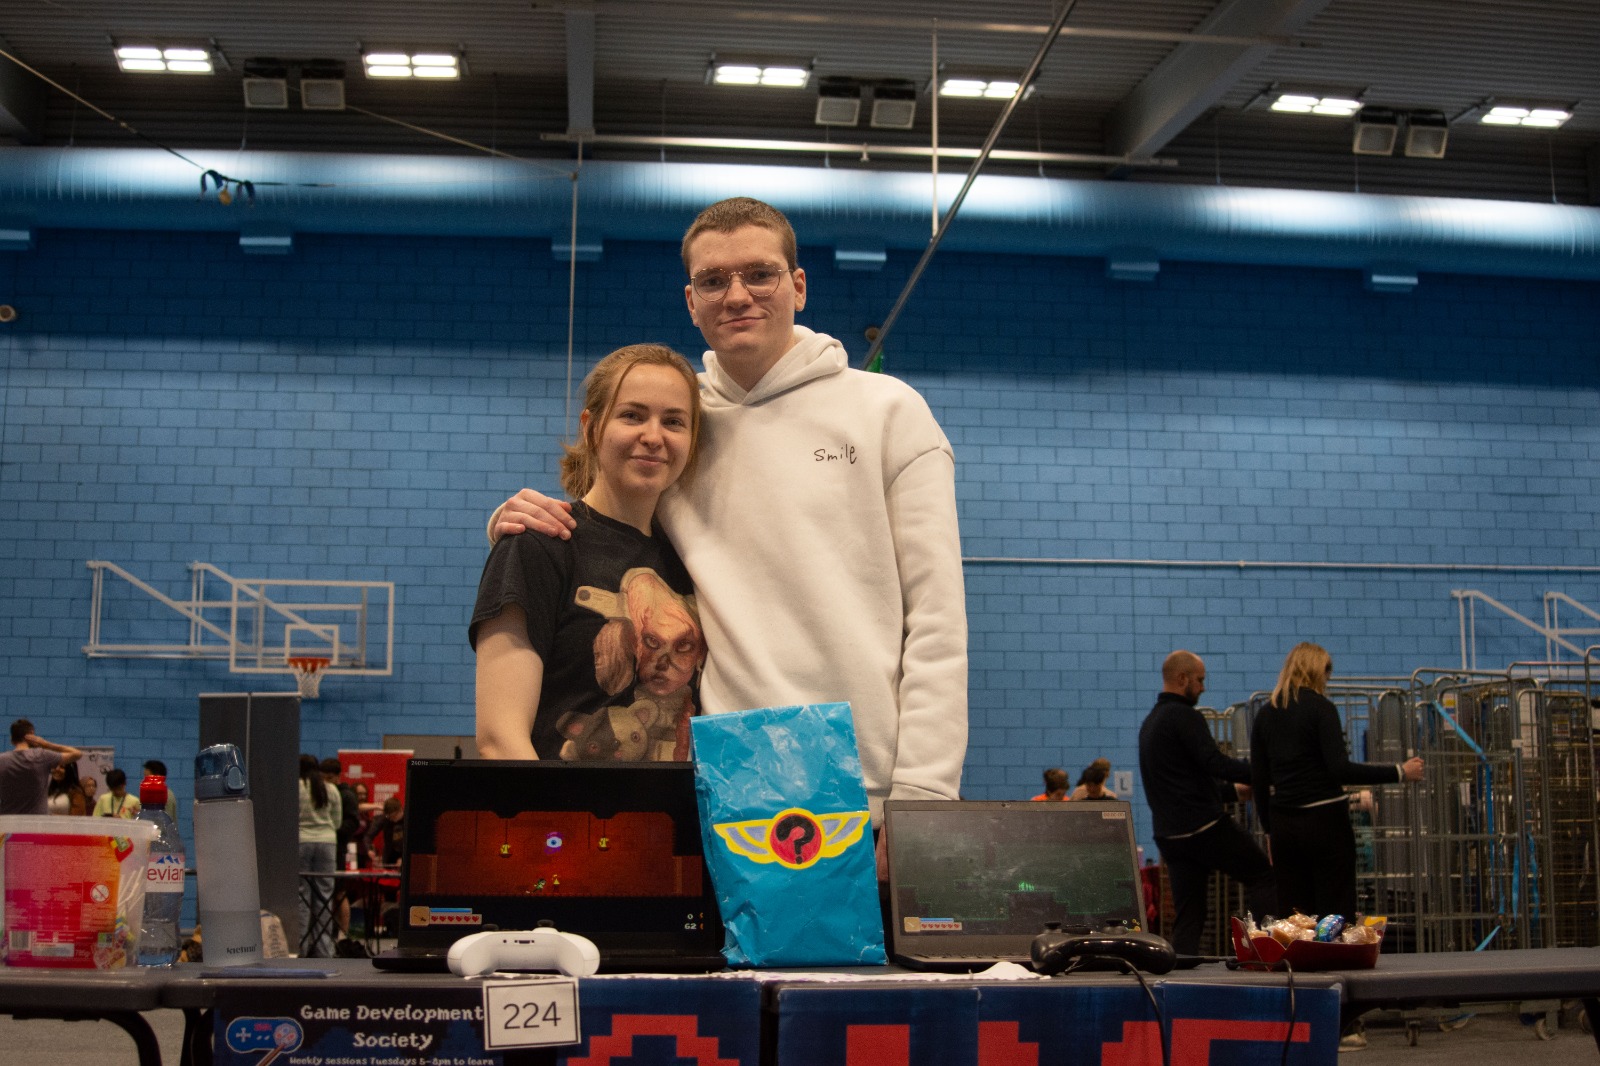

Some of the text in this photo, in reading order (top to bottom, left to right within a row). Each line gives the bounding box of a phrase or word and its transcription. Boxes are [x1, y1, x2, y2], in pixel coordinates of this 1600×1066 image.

[300, 1003, 484, 1023] Game Development
[503, 1001, 562, 1030] 224
[353, 1031, 433, 1051] Society
[324, 1057, 367, 1065] sessions
[370, 1057, 417, 1066] Tuesdays
[467, 1057, 494, 1065] learn
